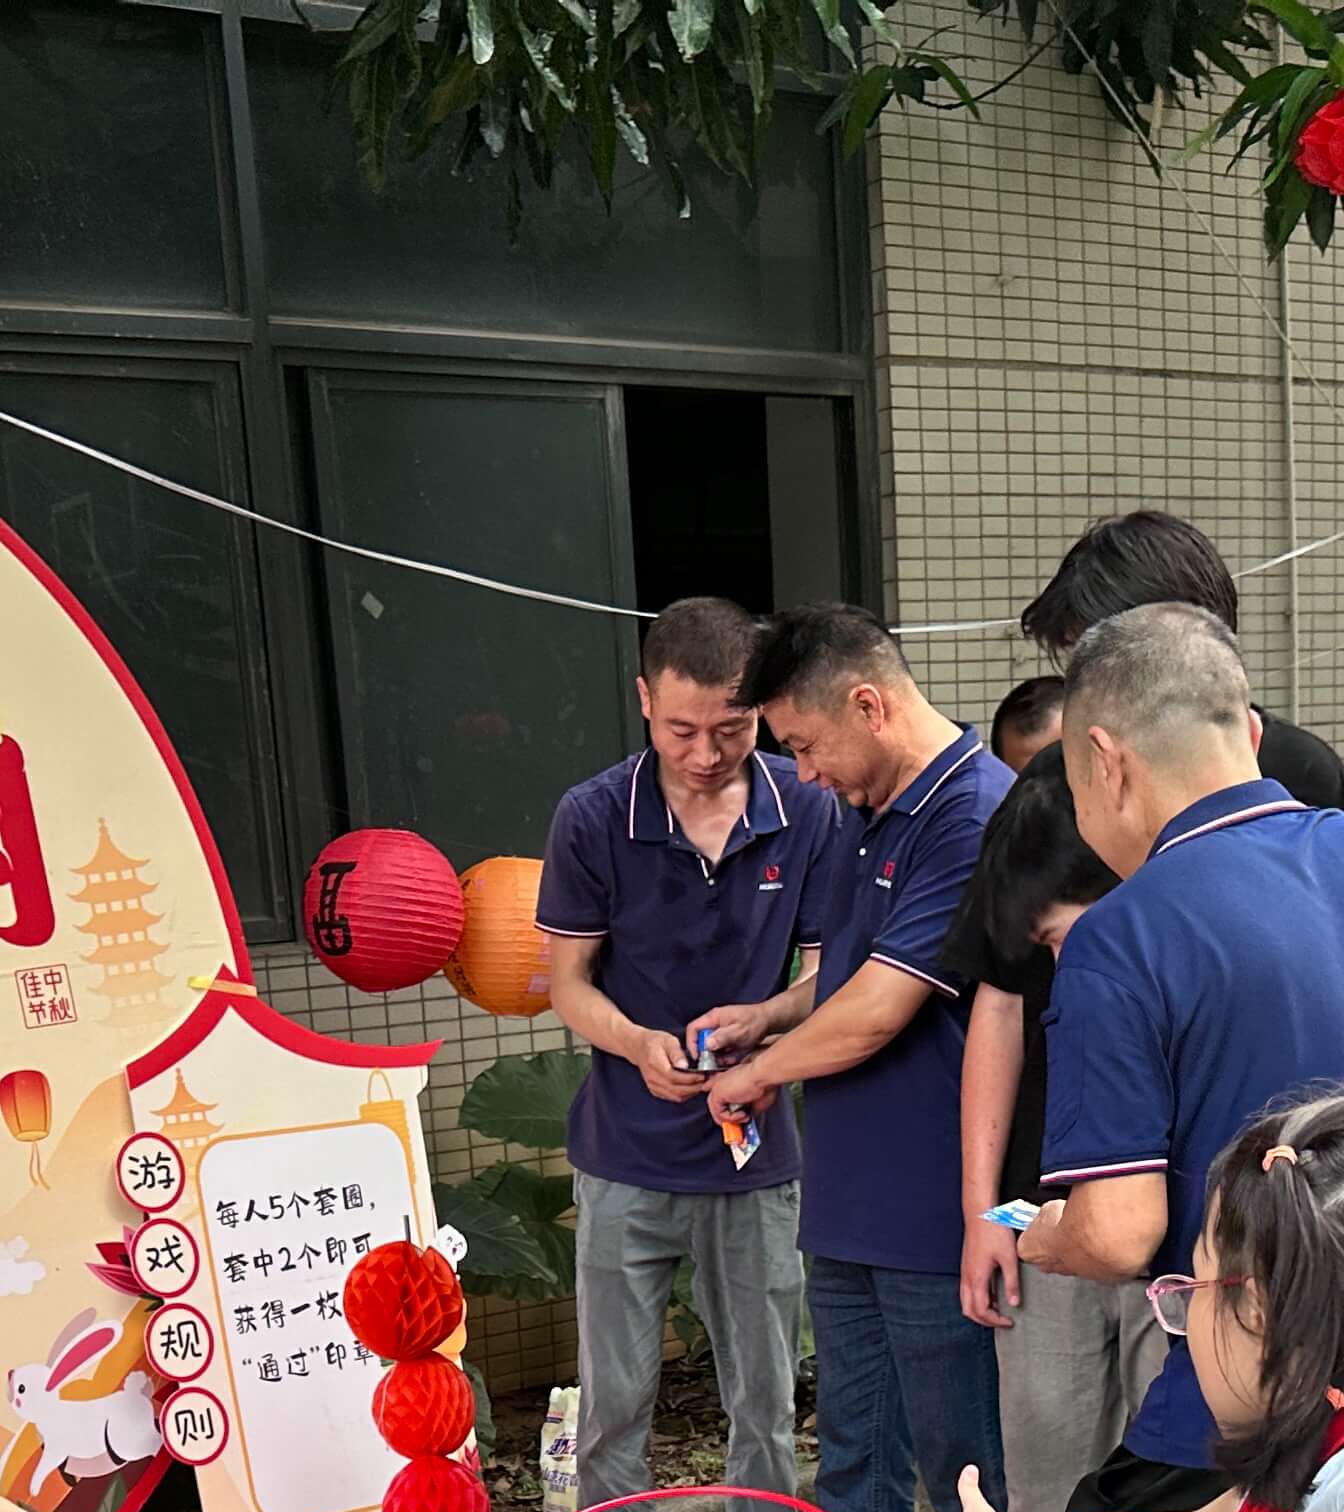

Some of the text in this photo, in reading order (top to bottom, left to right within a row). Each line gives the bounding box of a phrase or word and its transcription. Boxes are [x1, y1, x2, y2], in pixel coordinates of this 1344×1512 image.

[223, 1232, 372, 1283] 套中2个即可
[128, 1151, 216, 1448] 游戏规则
[233, 1290, 344, 1335] 获得一枚
